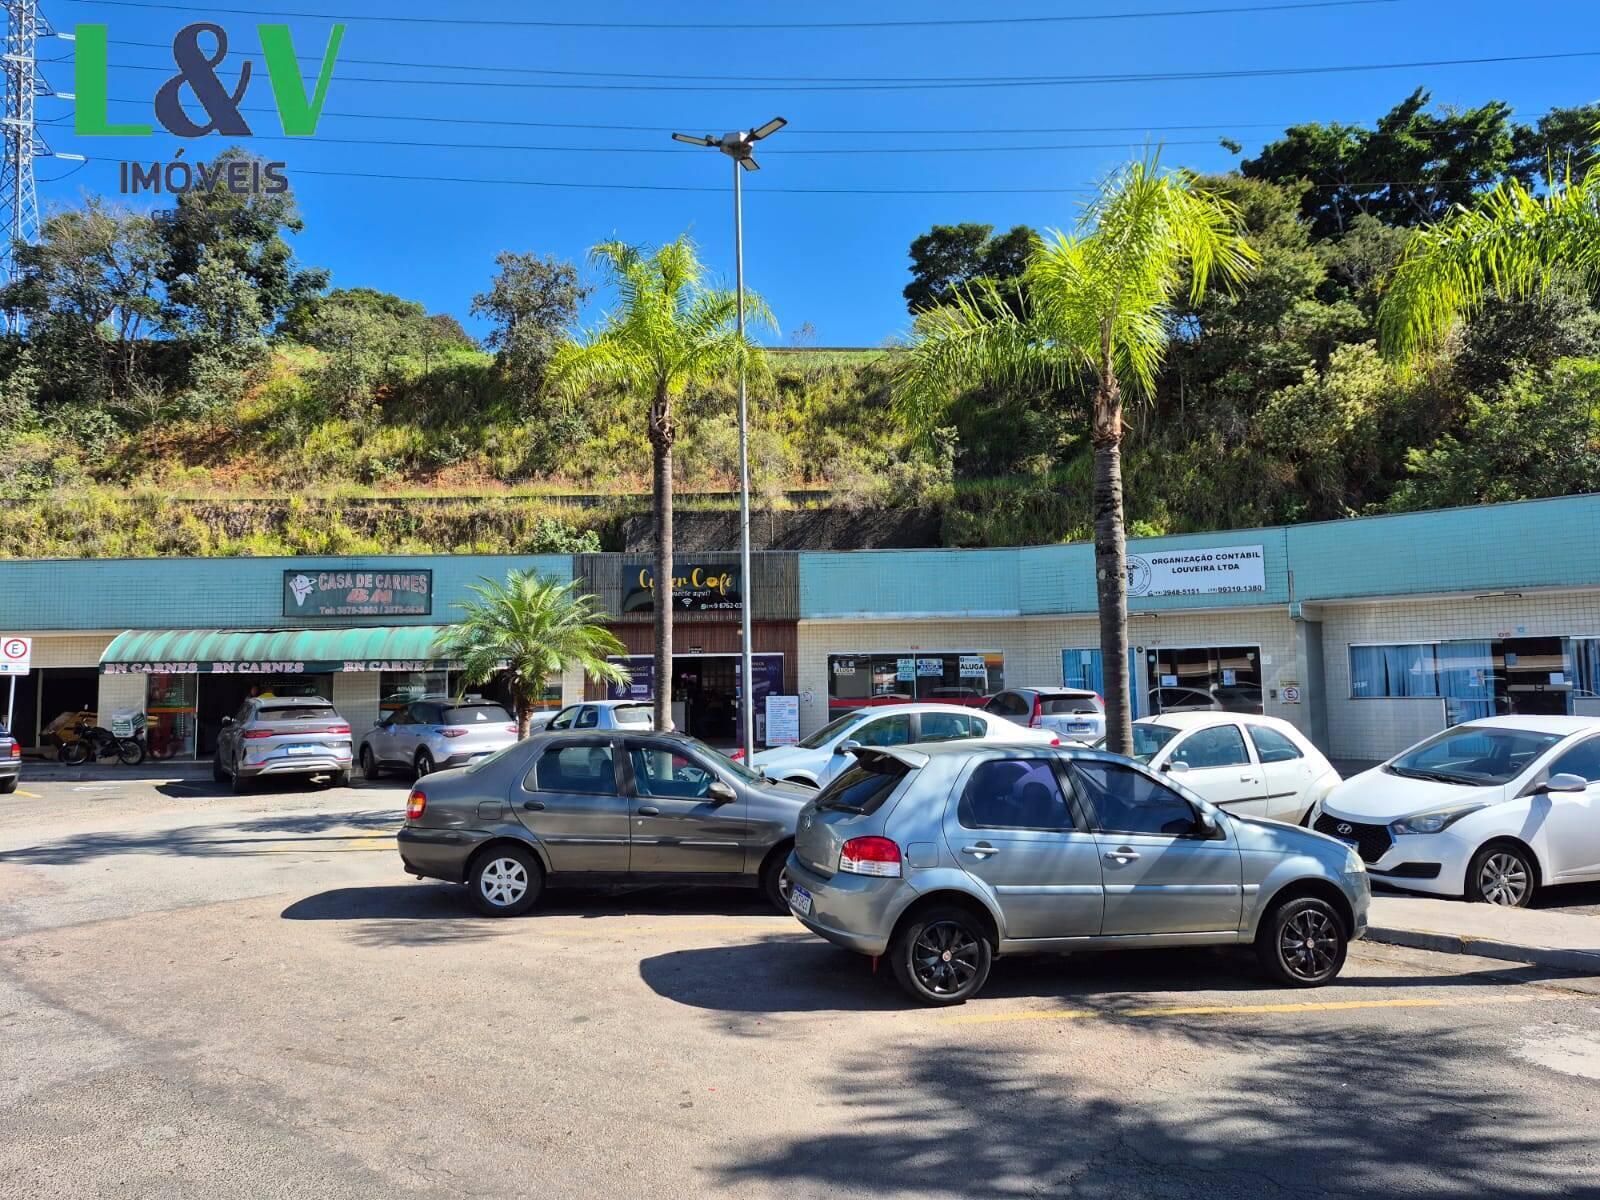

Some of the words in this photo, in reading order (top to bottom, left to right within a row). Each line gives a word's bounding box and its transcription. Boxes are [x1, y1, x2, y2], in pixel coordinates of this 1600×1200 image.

[1151, 554, 1213, 565] ORGANIZAÇÃO
[1172, 565, 1214, 574] LOUVEIRA
[1217, 563, 1239, 571] LTDA
[318, 573, 353, 591] CASA
[356, 574, 373, 588] DE
[375, 574, 427, 594] CARNES
[692, 567, 732, 595] Café
[12, 644, 19, 654] E
[130, 663, 198, 673] CARNES
[238, 662, 305, 673] CARNES
